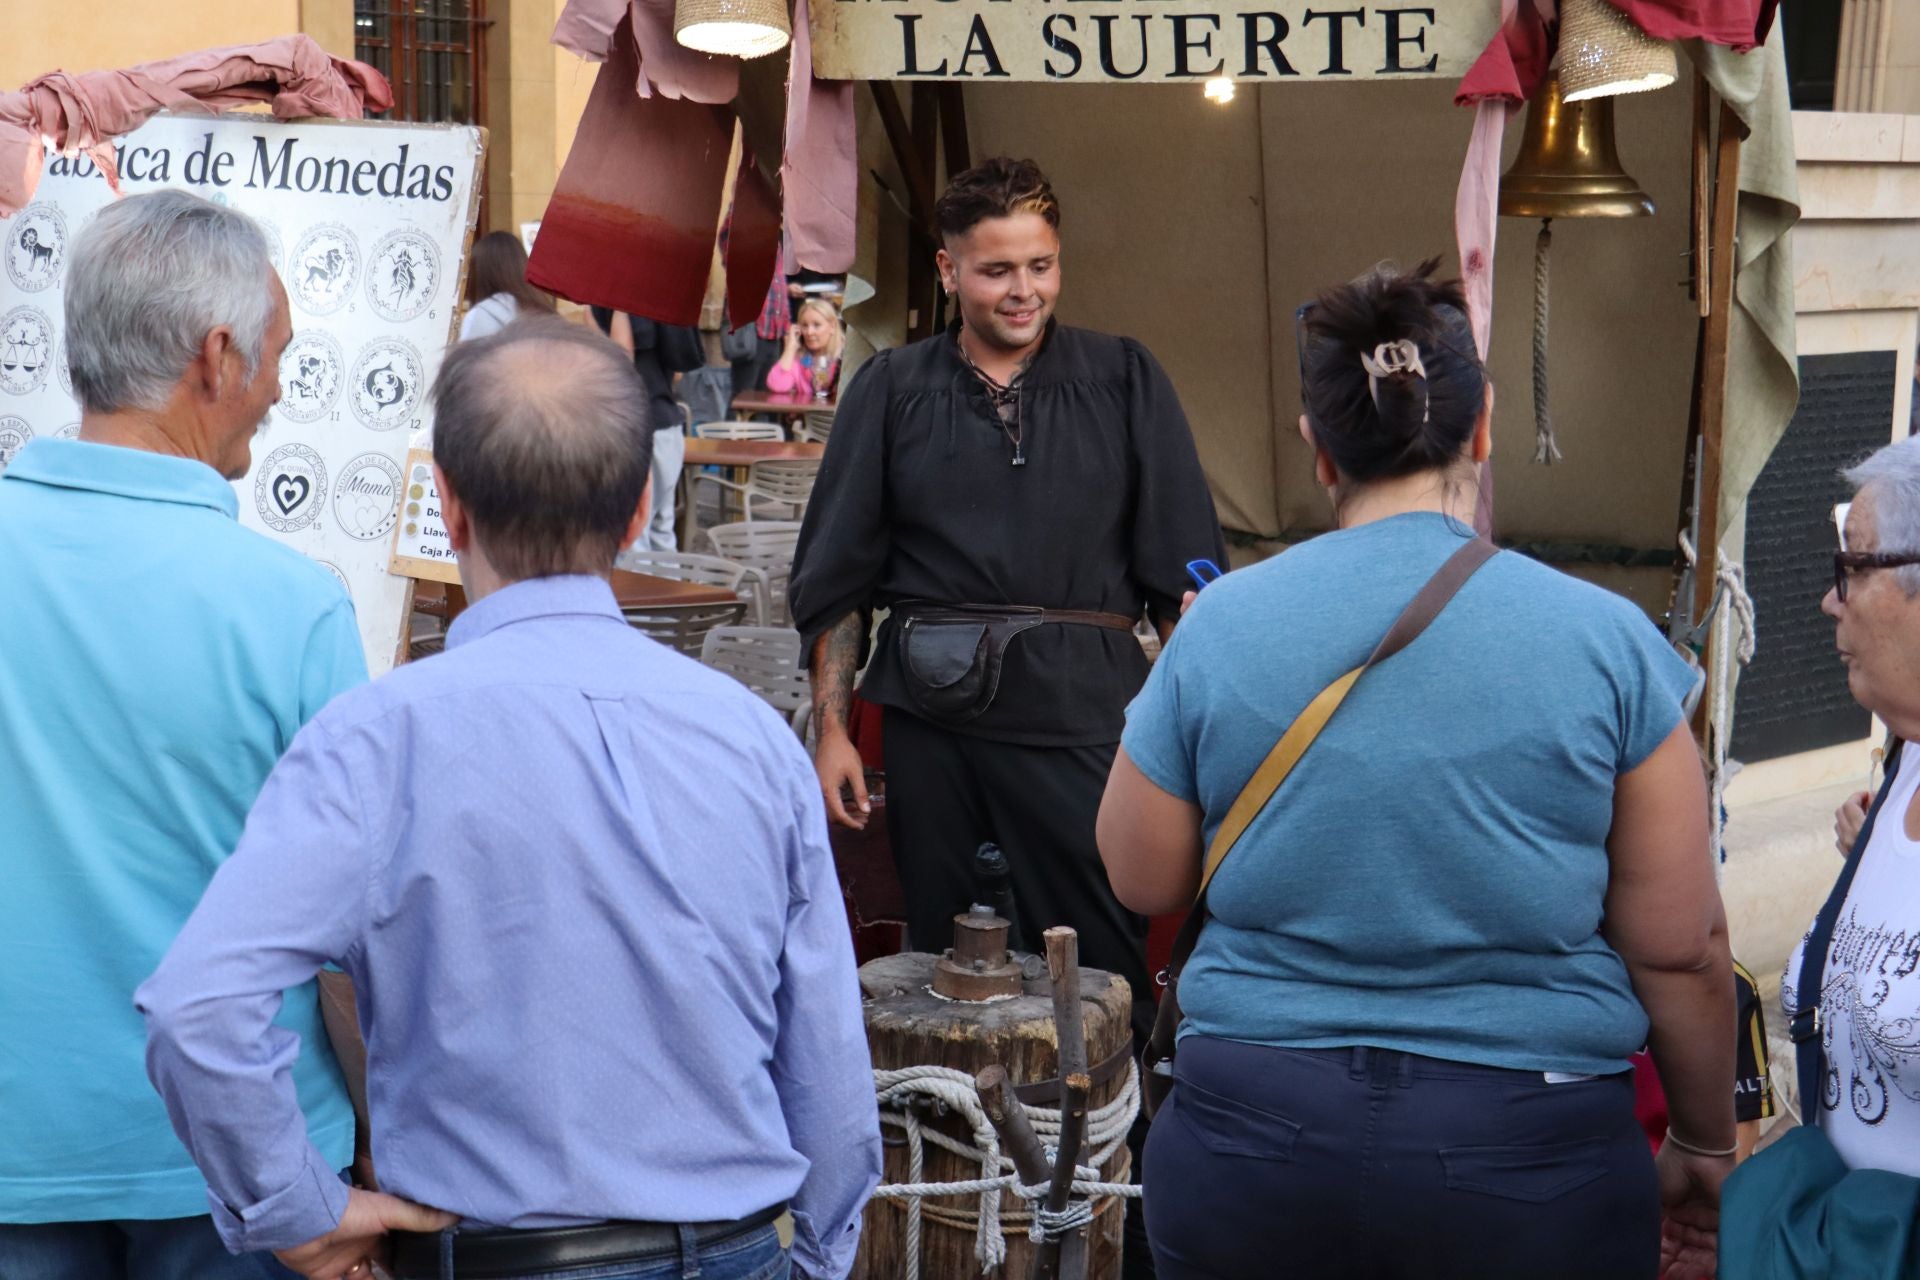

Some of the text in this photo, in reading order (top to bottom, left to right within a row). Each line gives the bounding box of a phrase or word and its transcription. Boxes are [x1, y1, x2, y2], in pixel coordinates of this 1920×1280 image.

[893, 7, 1439, 79] LA SUERTE
[184, 132, 235, 187] de
[244, 135, 454, 202] Monedas
[429, 309, 436, 320] 6
[41, 383, 48, 393] 7
[330, 410, 341, 422] 11
[409, 418, 421, 430] 12
[346, 475, 392, 496] Mama
[427, 507, 443, 518] Do
[420, 545, 443, 558] Caja
